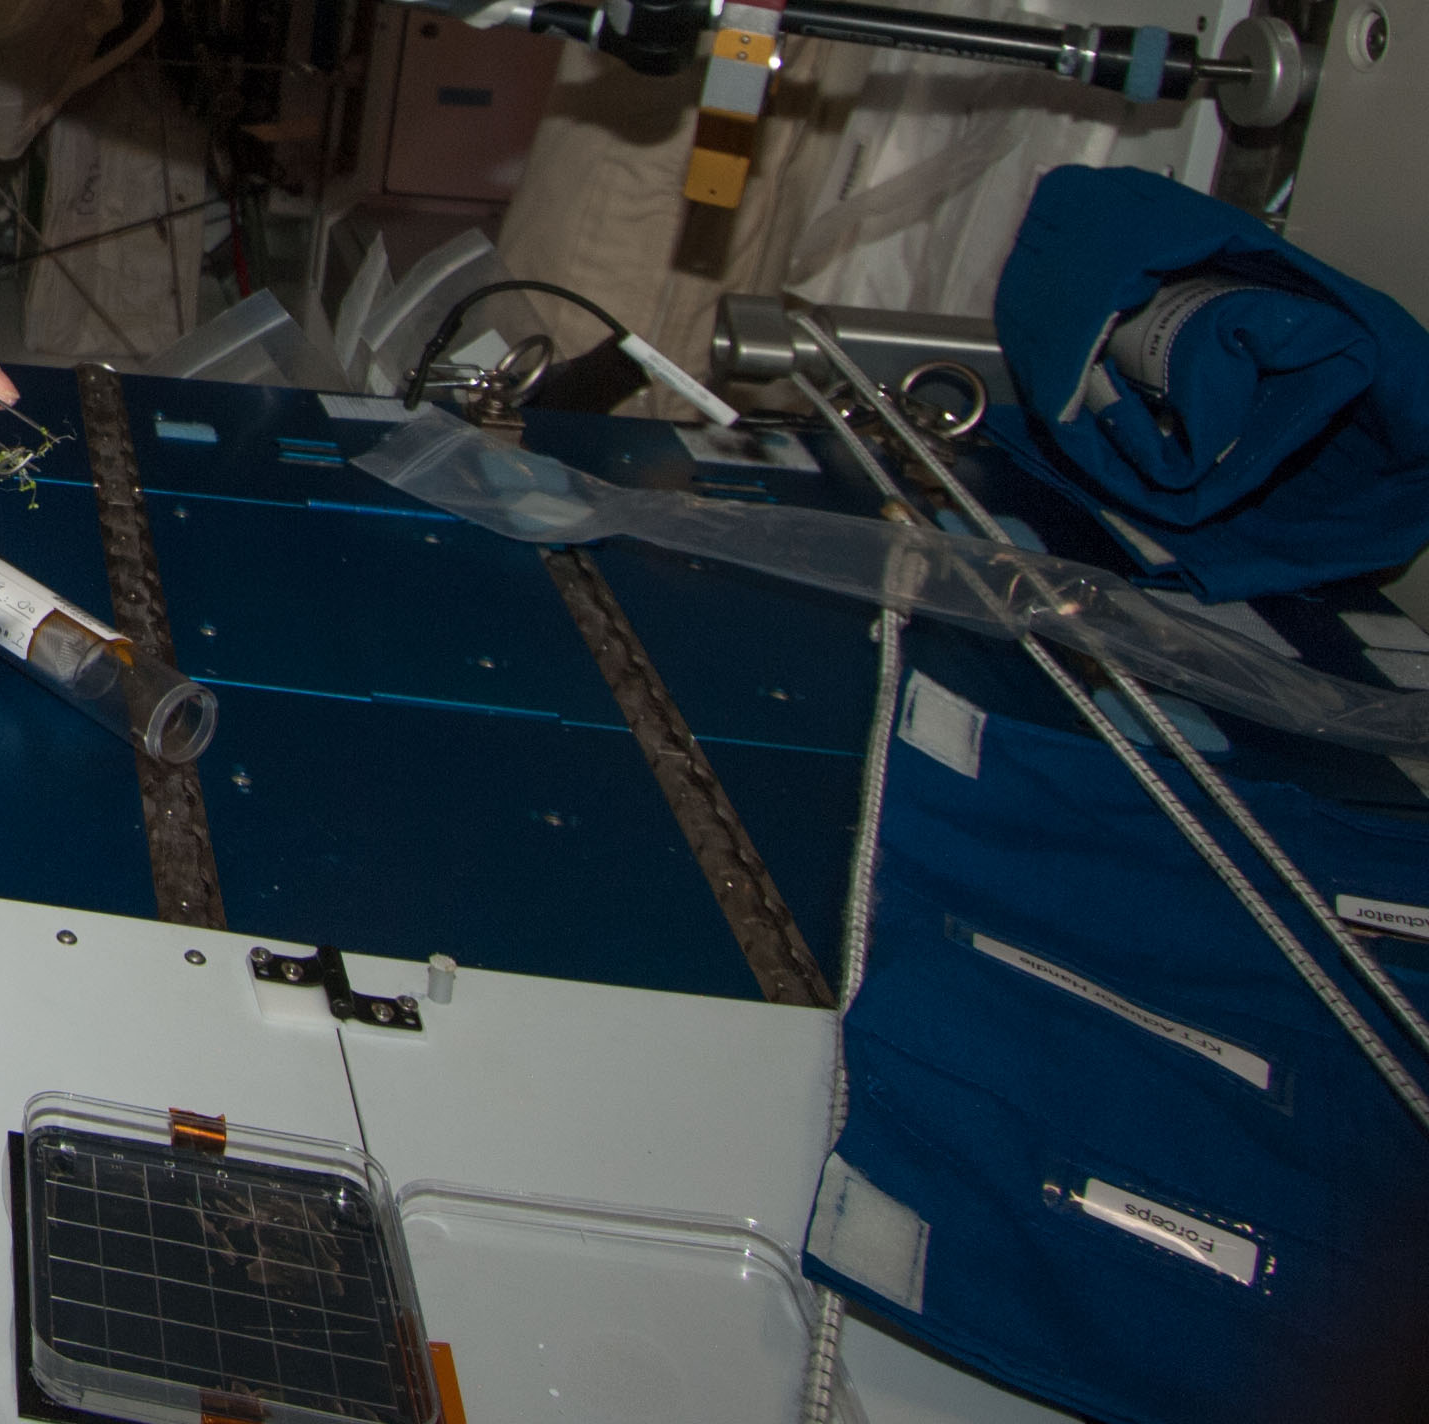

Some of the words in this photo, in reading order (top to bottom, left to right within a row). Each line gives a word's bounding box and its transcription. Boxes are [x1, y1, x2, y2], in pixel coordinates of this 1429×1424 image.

[1018, 955, 1089, 993] Handle
[1095, 990, 1175, 1033] Actuator
[1182, 1030, 1223, 1056] KFT
[1125, 1202, 1216, 1253] Forceps
